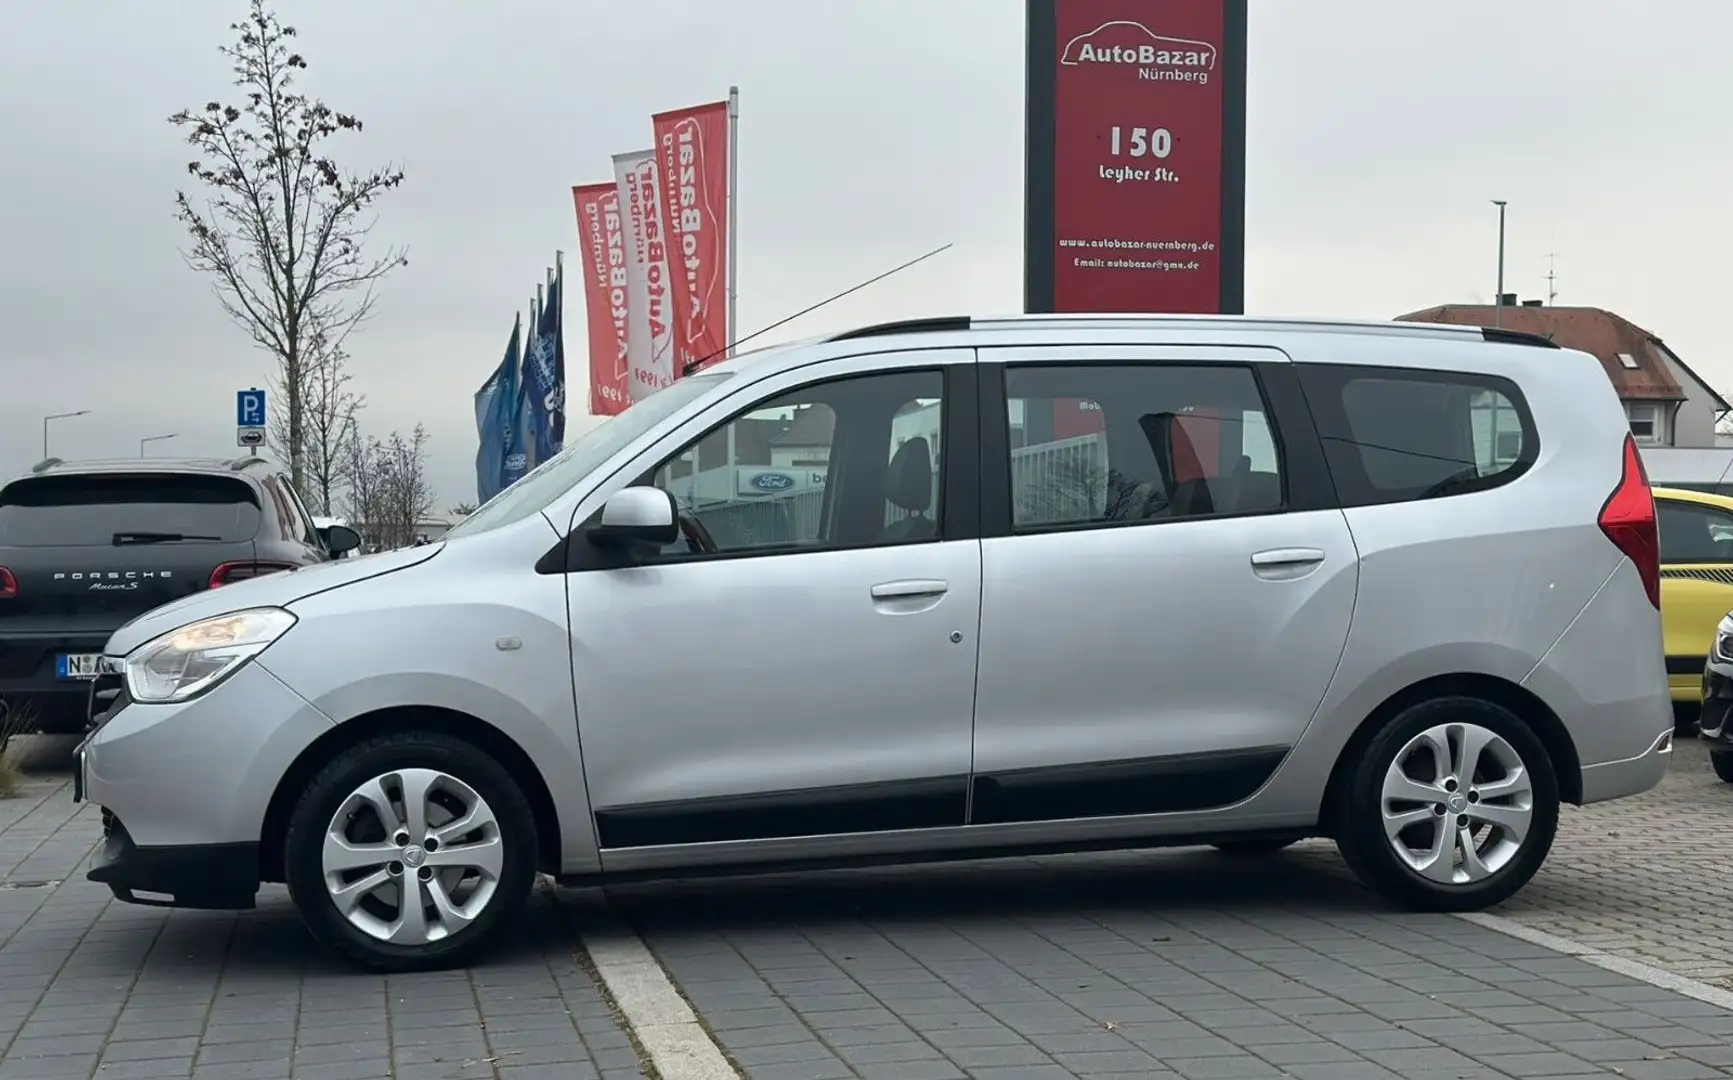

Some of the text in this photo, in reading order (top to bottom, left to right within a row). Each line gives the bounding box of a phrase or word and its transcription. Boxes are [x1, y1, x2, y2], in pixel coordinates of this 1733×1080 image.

[1078, 43, 1209, 66] AutoBazar
[1138, 68, 1208, 84] Nürnberg
[1111, 126, 1171, 158] 150
[1099, 165, 1179, 183] Leyher Str.
[1059, 239, 1215, 252] www.autobazar-nuernberg.de
[1074, 258, 1200, 271] Email: autobazar@gmx.de
[244, 396, 258, 422] P
[54, 571, 171, 579] PORSCHE
[69, 656, 81, 673] N
